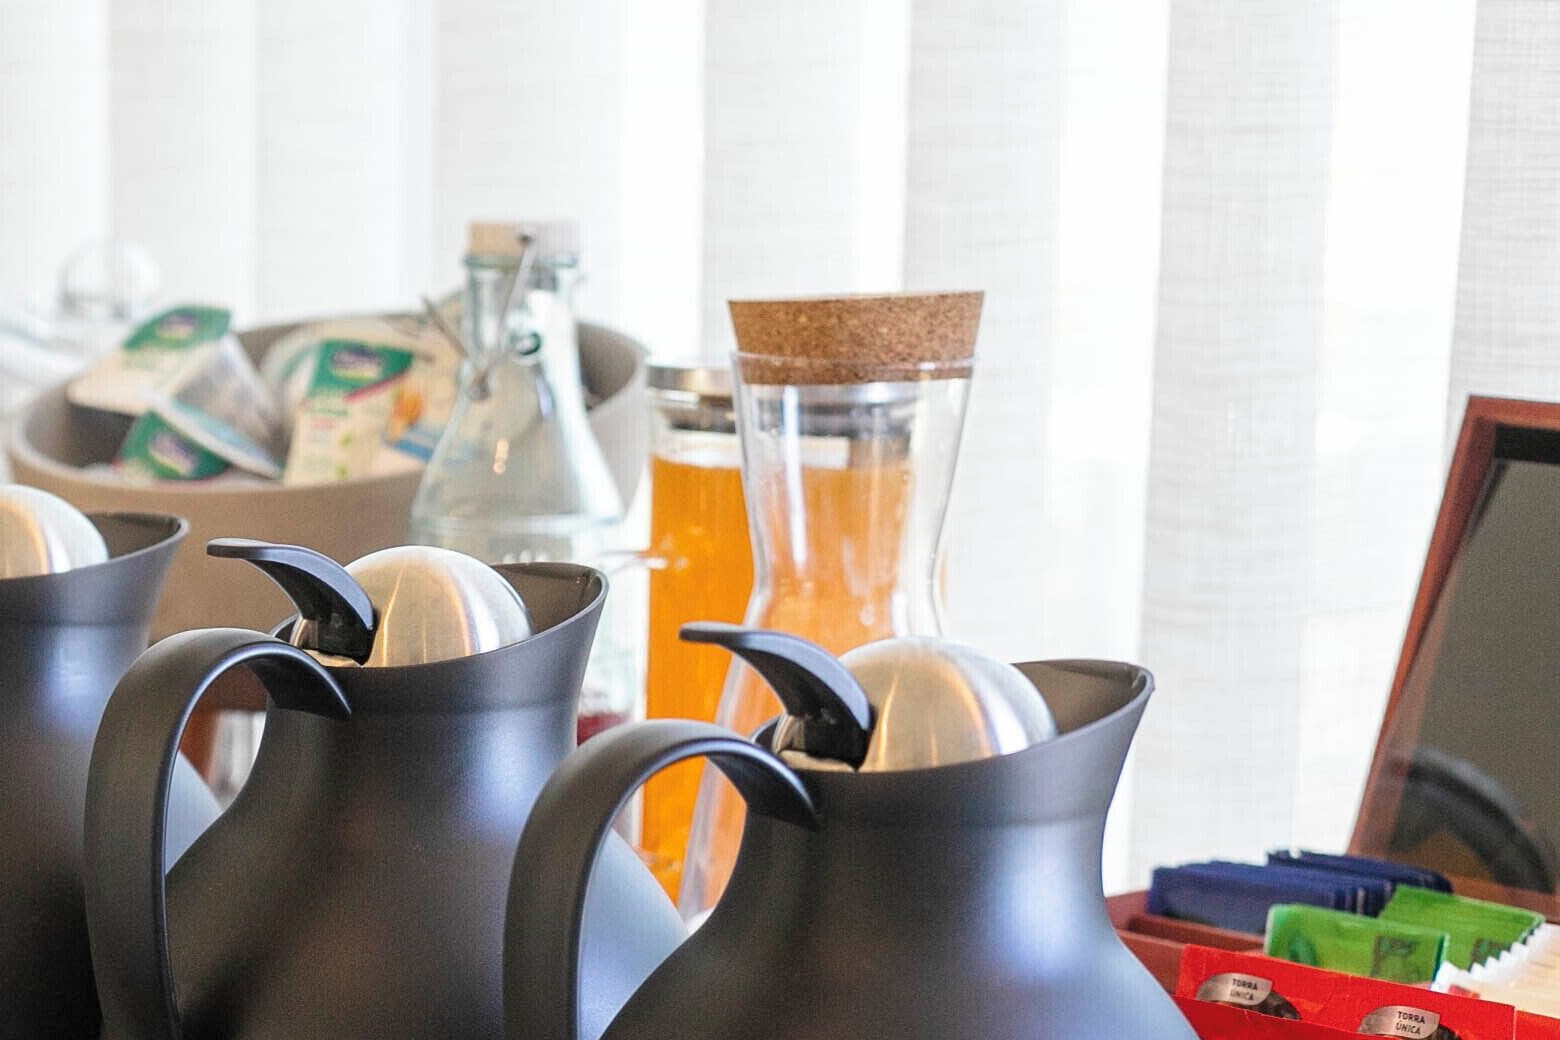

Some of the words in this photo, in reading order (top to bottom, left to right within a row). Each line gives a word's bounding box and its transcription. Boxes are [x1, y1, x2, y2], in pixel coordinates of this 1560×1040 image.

[1232, 978, 1258, 991] TORRA
[1397, 1011, 1426, 1025] TORRA
[1395, 1021, 1421, 1035] ÚNICA
